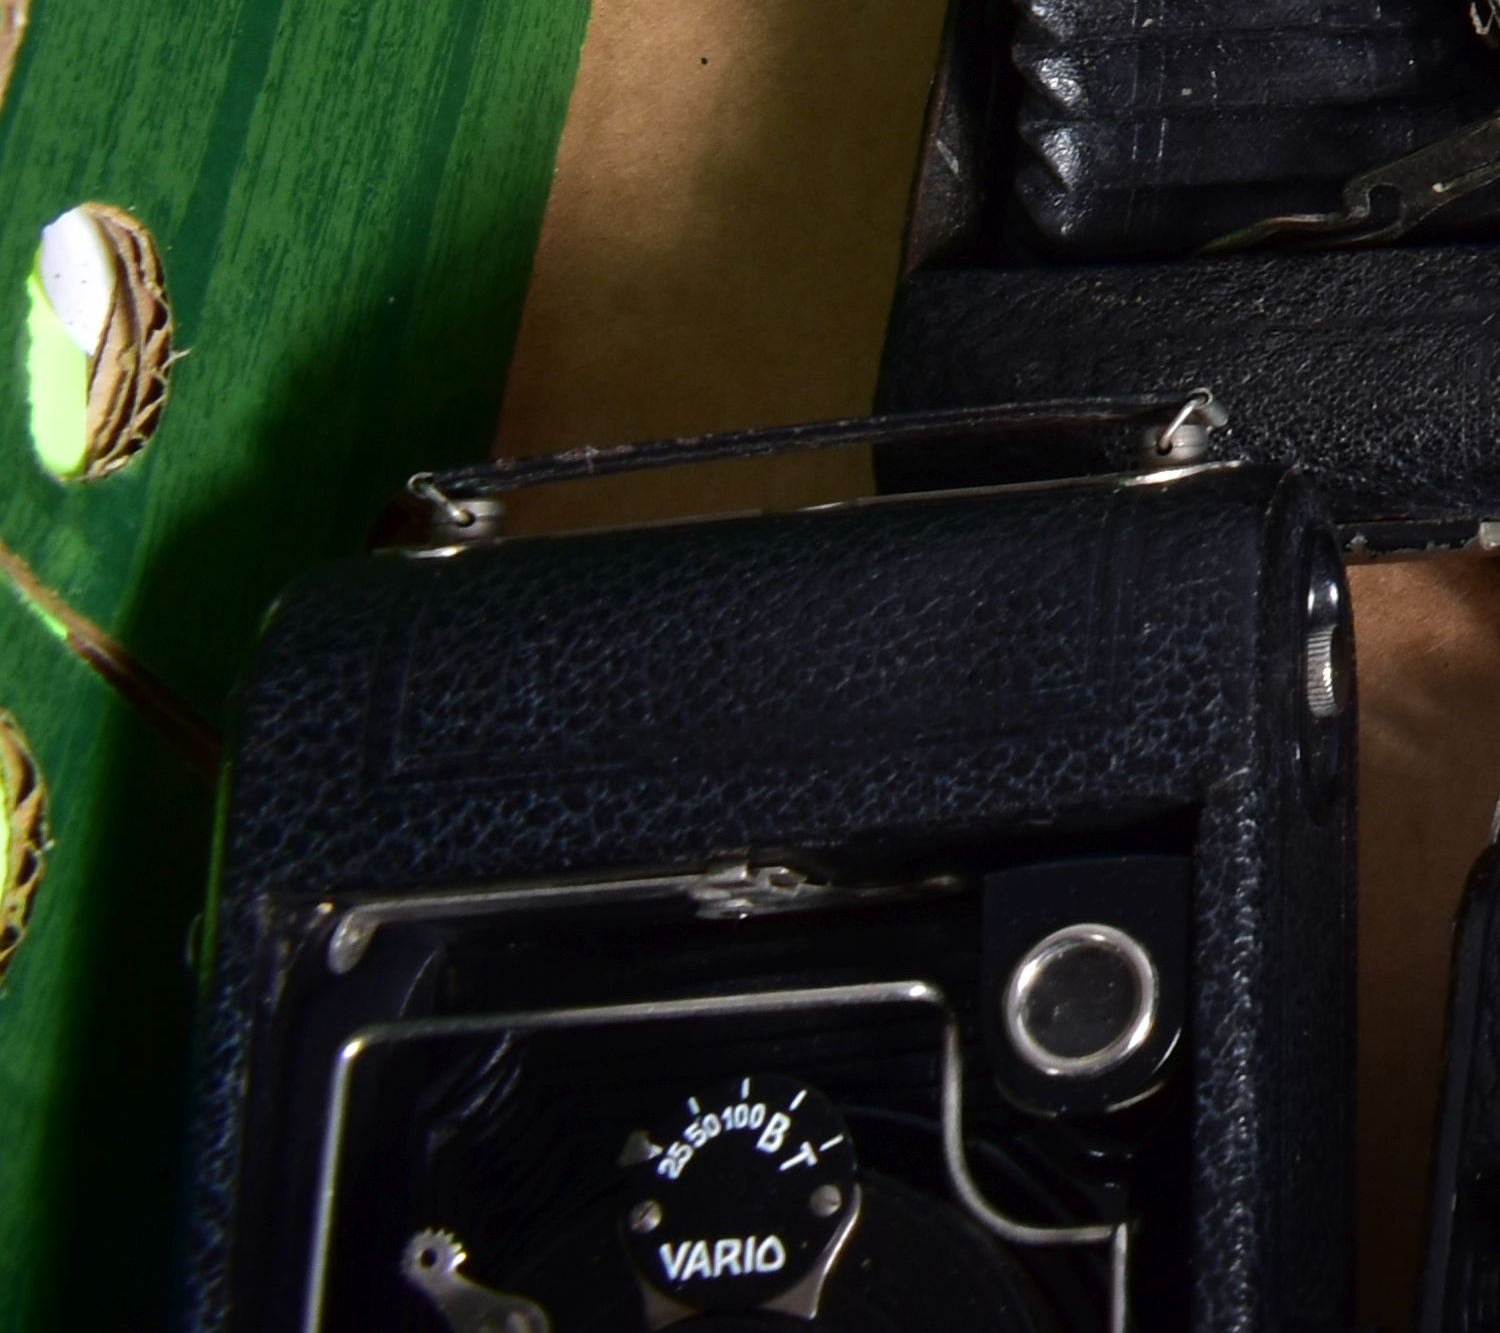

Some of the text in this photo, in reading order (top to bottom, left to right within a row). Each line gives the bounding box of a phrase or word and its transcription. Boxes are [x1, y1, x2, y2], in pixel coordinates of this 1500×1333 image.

[657, 1102, 819, 1180] 25 50 100 B T
[658, 1234, 787, 1281] VARIO
